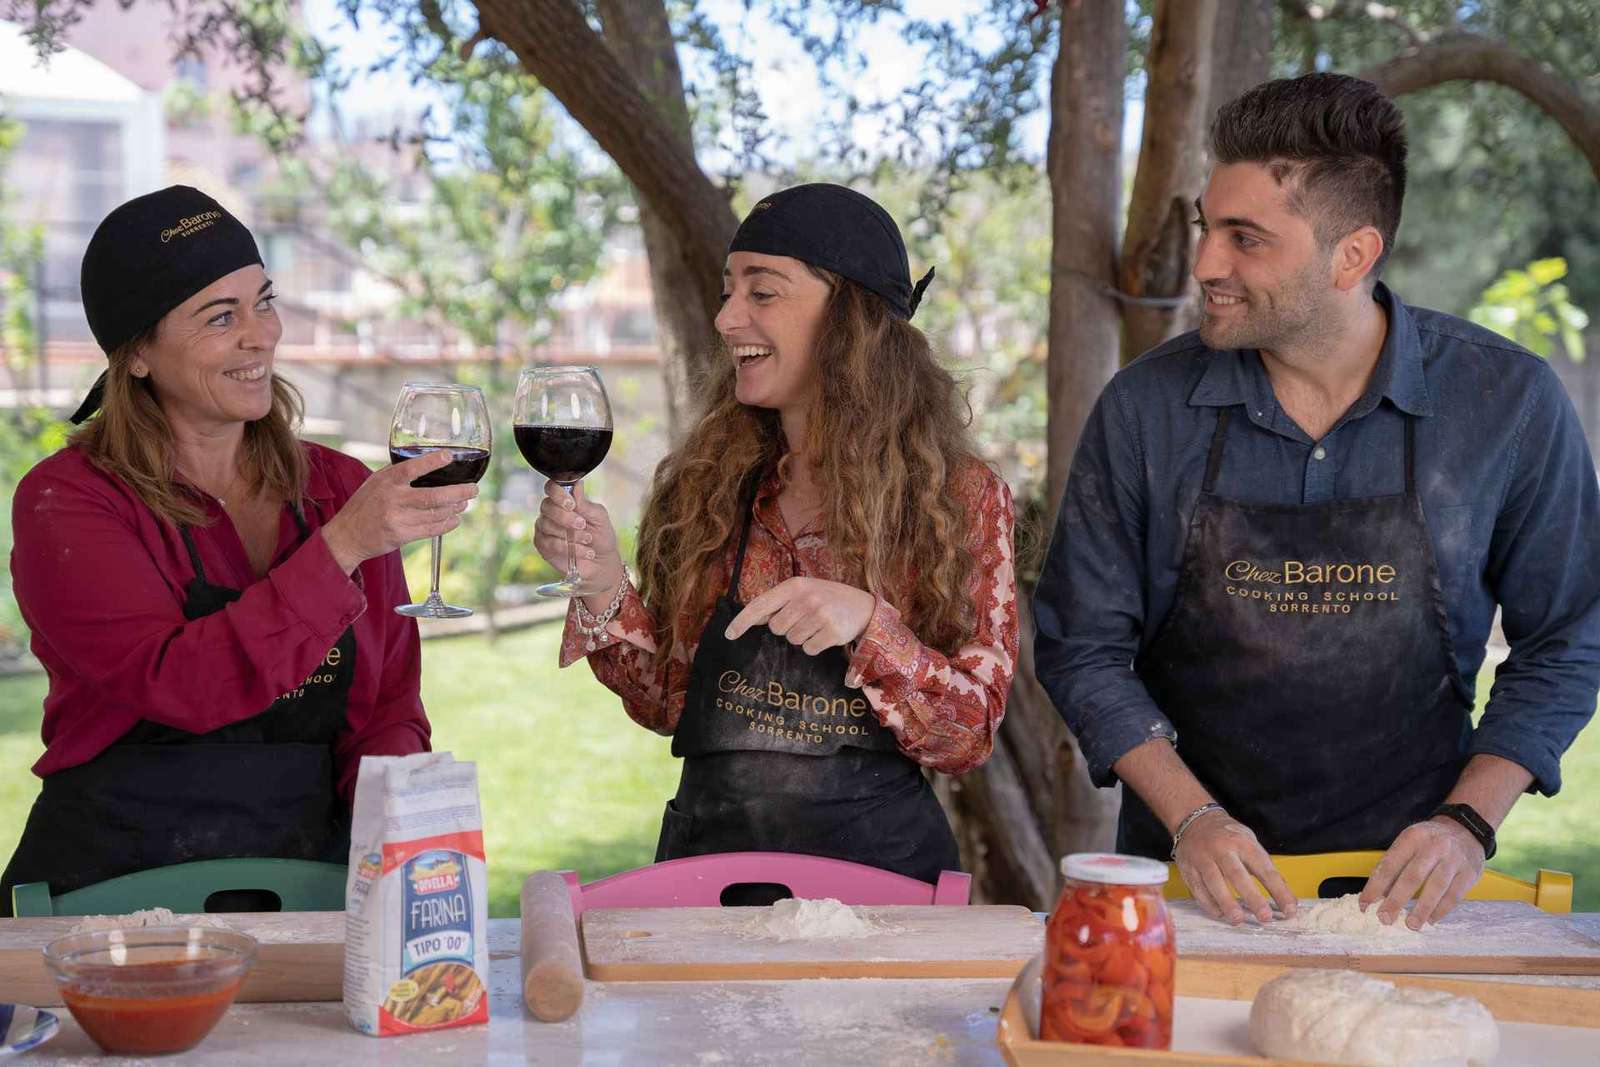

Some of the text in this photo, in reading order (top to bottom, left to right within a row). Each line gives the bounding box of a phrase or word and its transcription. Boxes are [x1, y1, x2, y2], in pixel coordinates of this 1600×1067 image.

[179, 210, 221, 229] Barone
[1225, 560, 1396, 585] Chez Barone
[1226, 585, 1400, 601] COOKING SCHOOL
[1269, 603, 1351, 614] SORRENTO
[718, 670, 867, 718] Chez Barone
[716, 697, 869, 736] COOKING SCHOOL
[749, 721, 824, 744] SORRENTO
[410, 894, 467, 930] FARINA
[413, 937, 441, 956] TIPO
